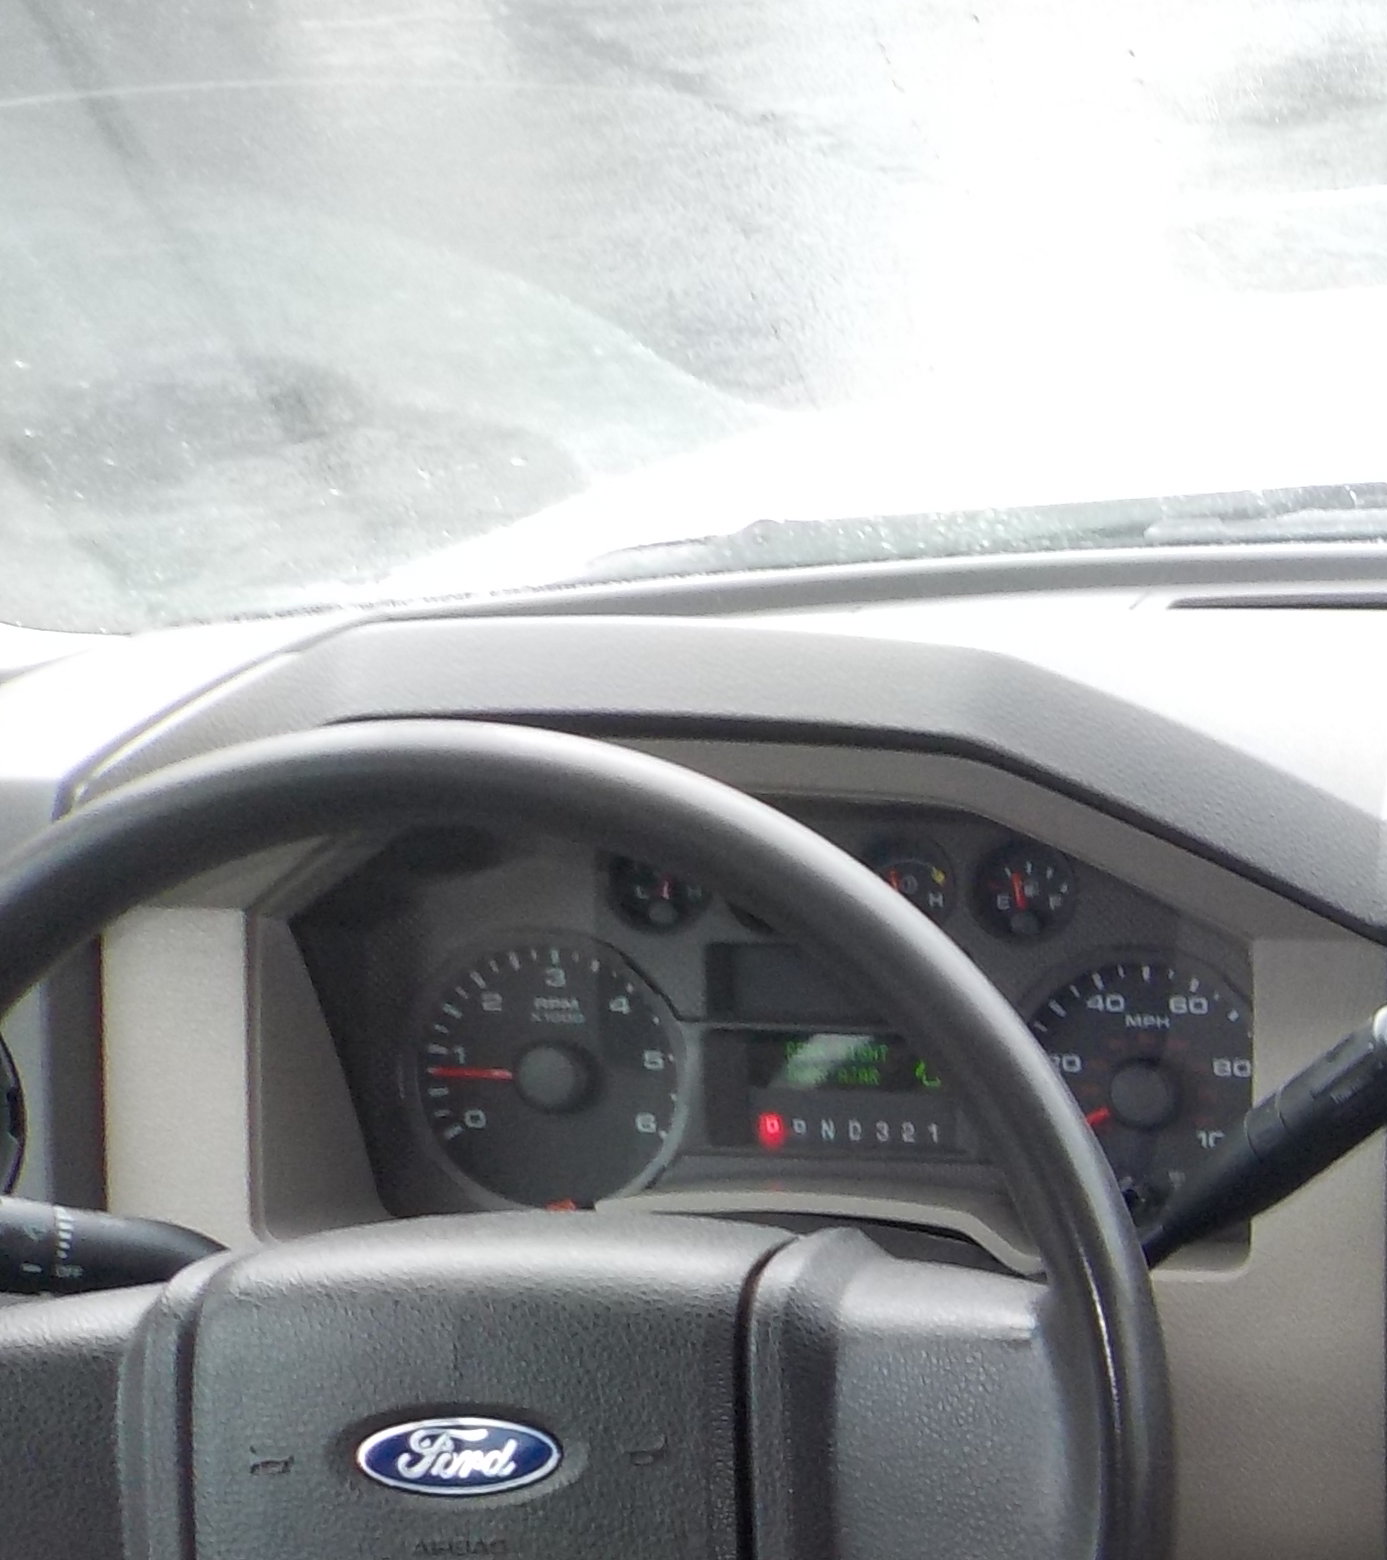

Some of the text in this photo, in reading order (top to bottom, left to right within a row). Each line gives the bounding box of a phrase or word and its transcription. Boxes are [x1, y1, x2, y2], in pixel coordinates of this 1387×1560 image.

[1085, 993, 1126, 1013] 40
[1168, 994, 1209, 1016] 60
[1124, 1013, 1171, 1029] MPH
[1211, 1057, 1251, 1079] 80
[875, 1120, 890, 1143] 3
[397, 1427, 518, 1479] Ford
